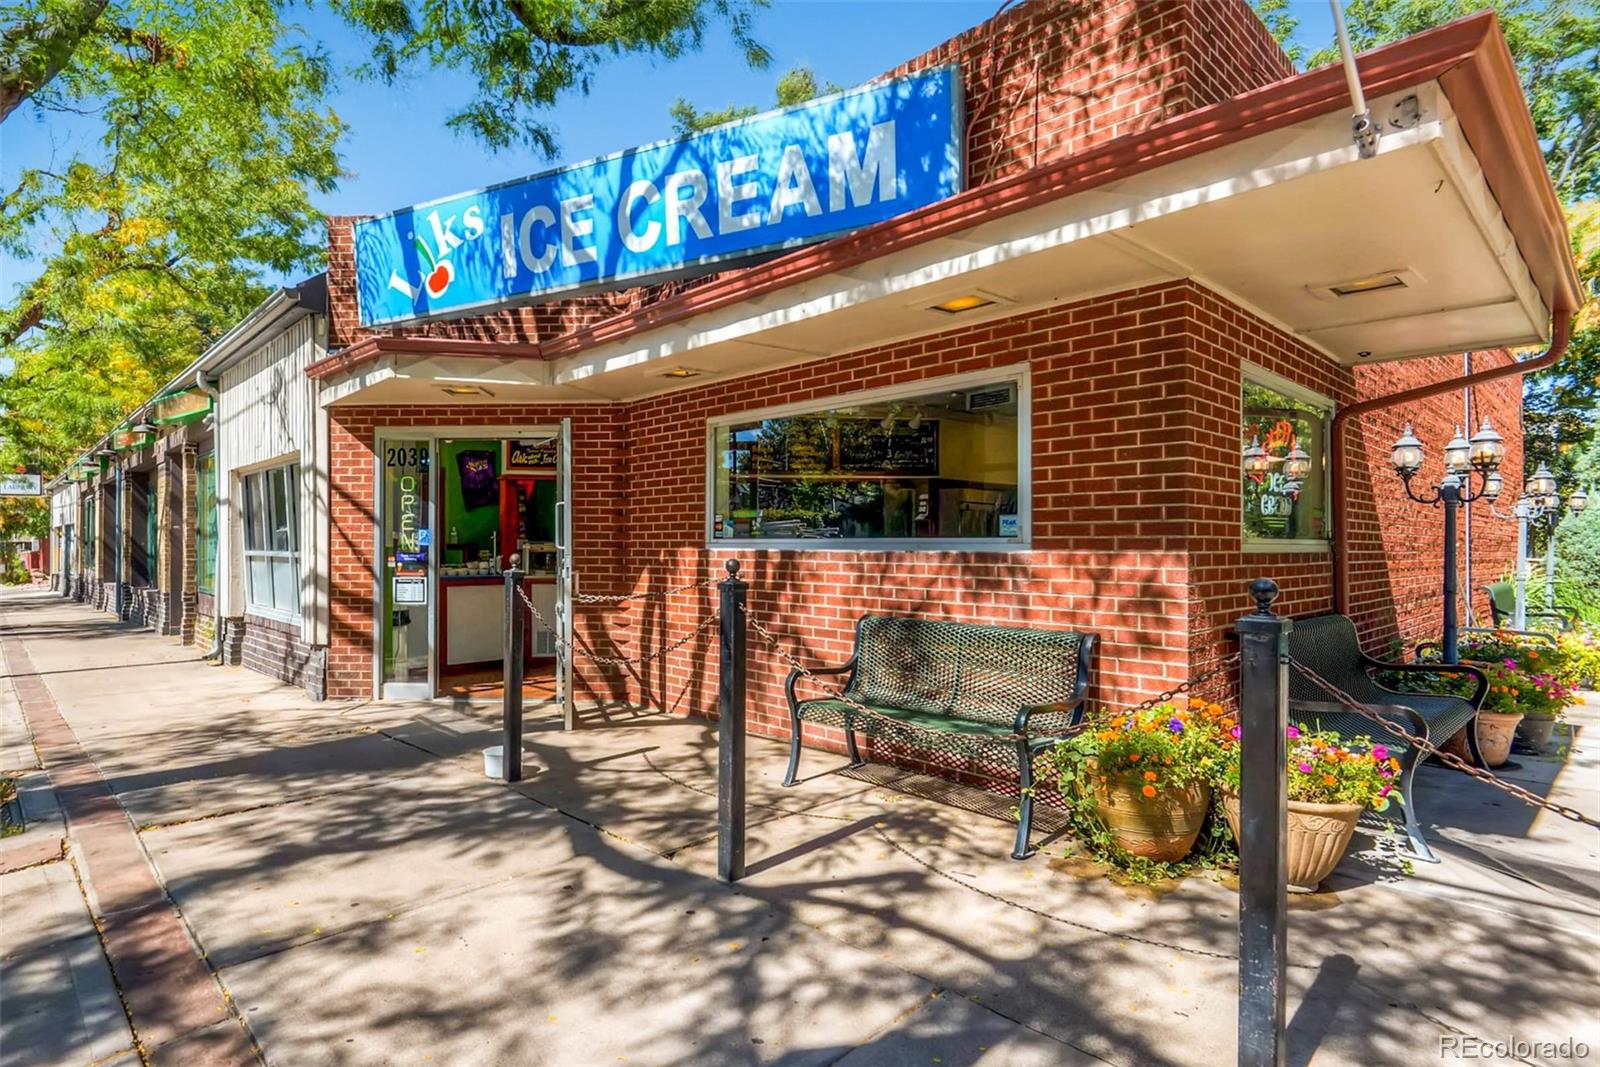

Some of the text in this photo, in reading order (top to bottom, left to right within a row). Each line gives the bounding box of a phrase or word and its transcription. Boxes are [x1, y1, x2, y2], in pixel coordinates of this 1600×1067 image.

[500, 194, 599, 279] ICE
[618, 121, 897, 253] CREAM
[400, 475, 416, 551] OPEN
